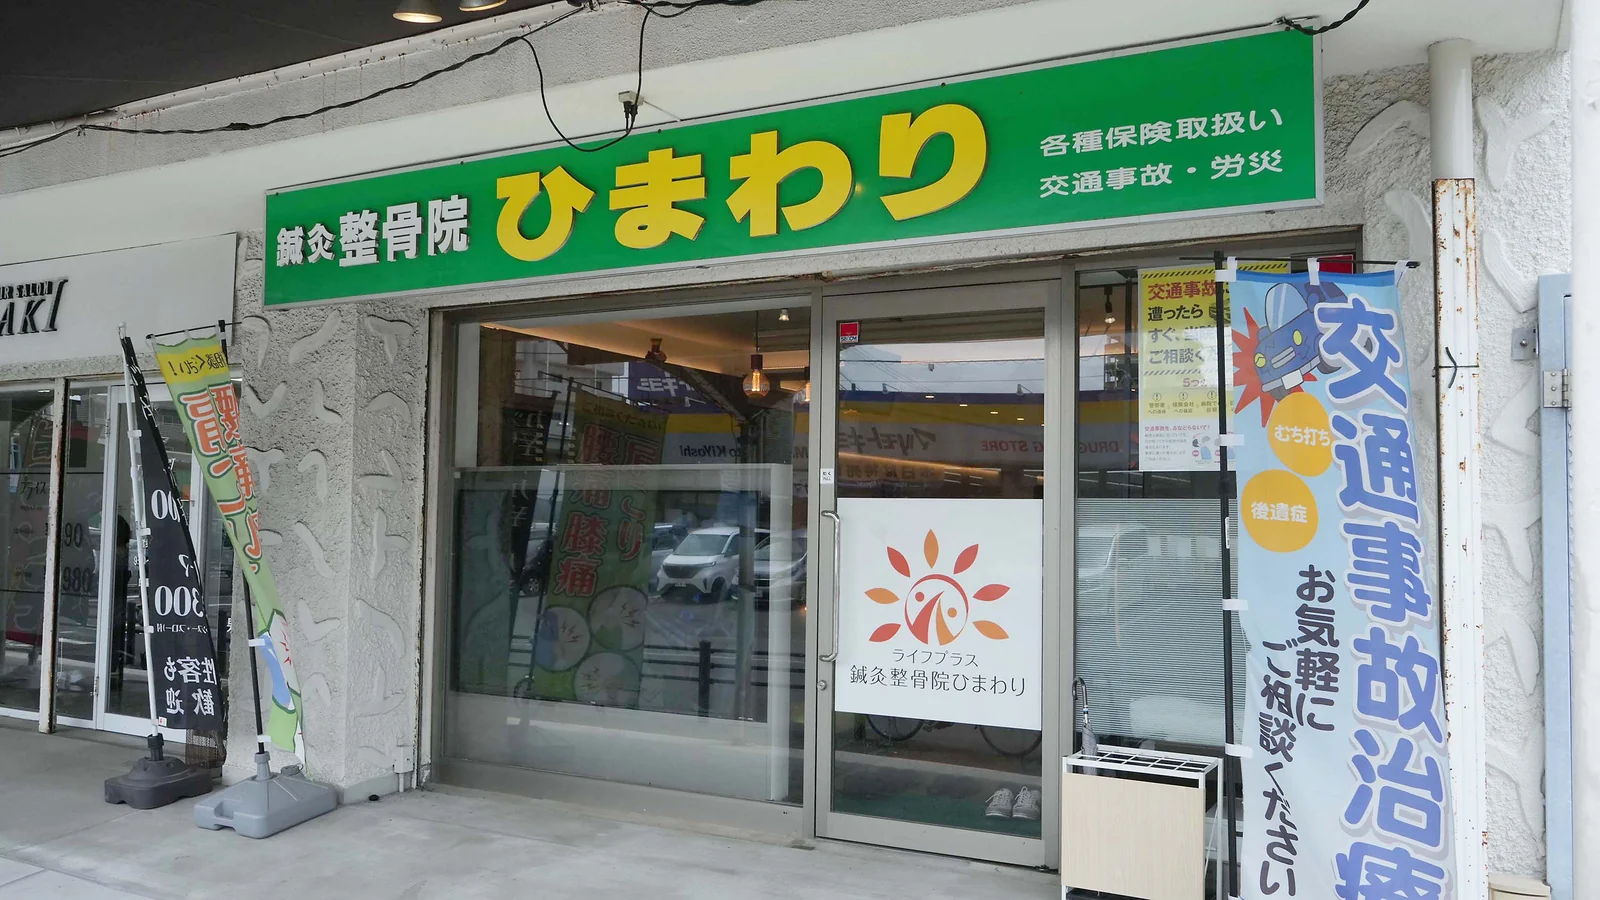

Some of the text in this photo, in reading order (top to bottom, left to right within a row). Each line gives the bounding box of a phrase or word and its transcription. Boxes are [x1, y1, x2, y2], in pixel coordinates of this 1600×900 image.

[1040, 108, 1283, 157] 各種保険取扱い
[276, 103, 988, 268] 鍼灸整骨院 ひまわり
[1039, 149, 1283, 198] 交通事故・労災
[15, 280, 54, 298] SALON
[1148, 304, 1204, 322] 遭ったら
[1273, 424, 1333, 446] むち打ち
[1250, 502, 1308, 523] 後遺症
[893, 649, 979, 668] ライフプラス
[1295, 564, 1340, 732] お気軽に
[850, 664, 1026, 697] 鍼灸整骨院ひまわり
[1258, 638, 1299, 897] ご相談ください
